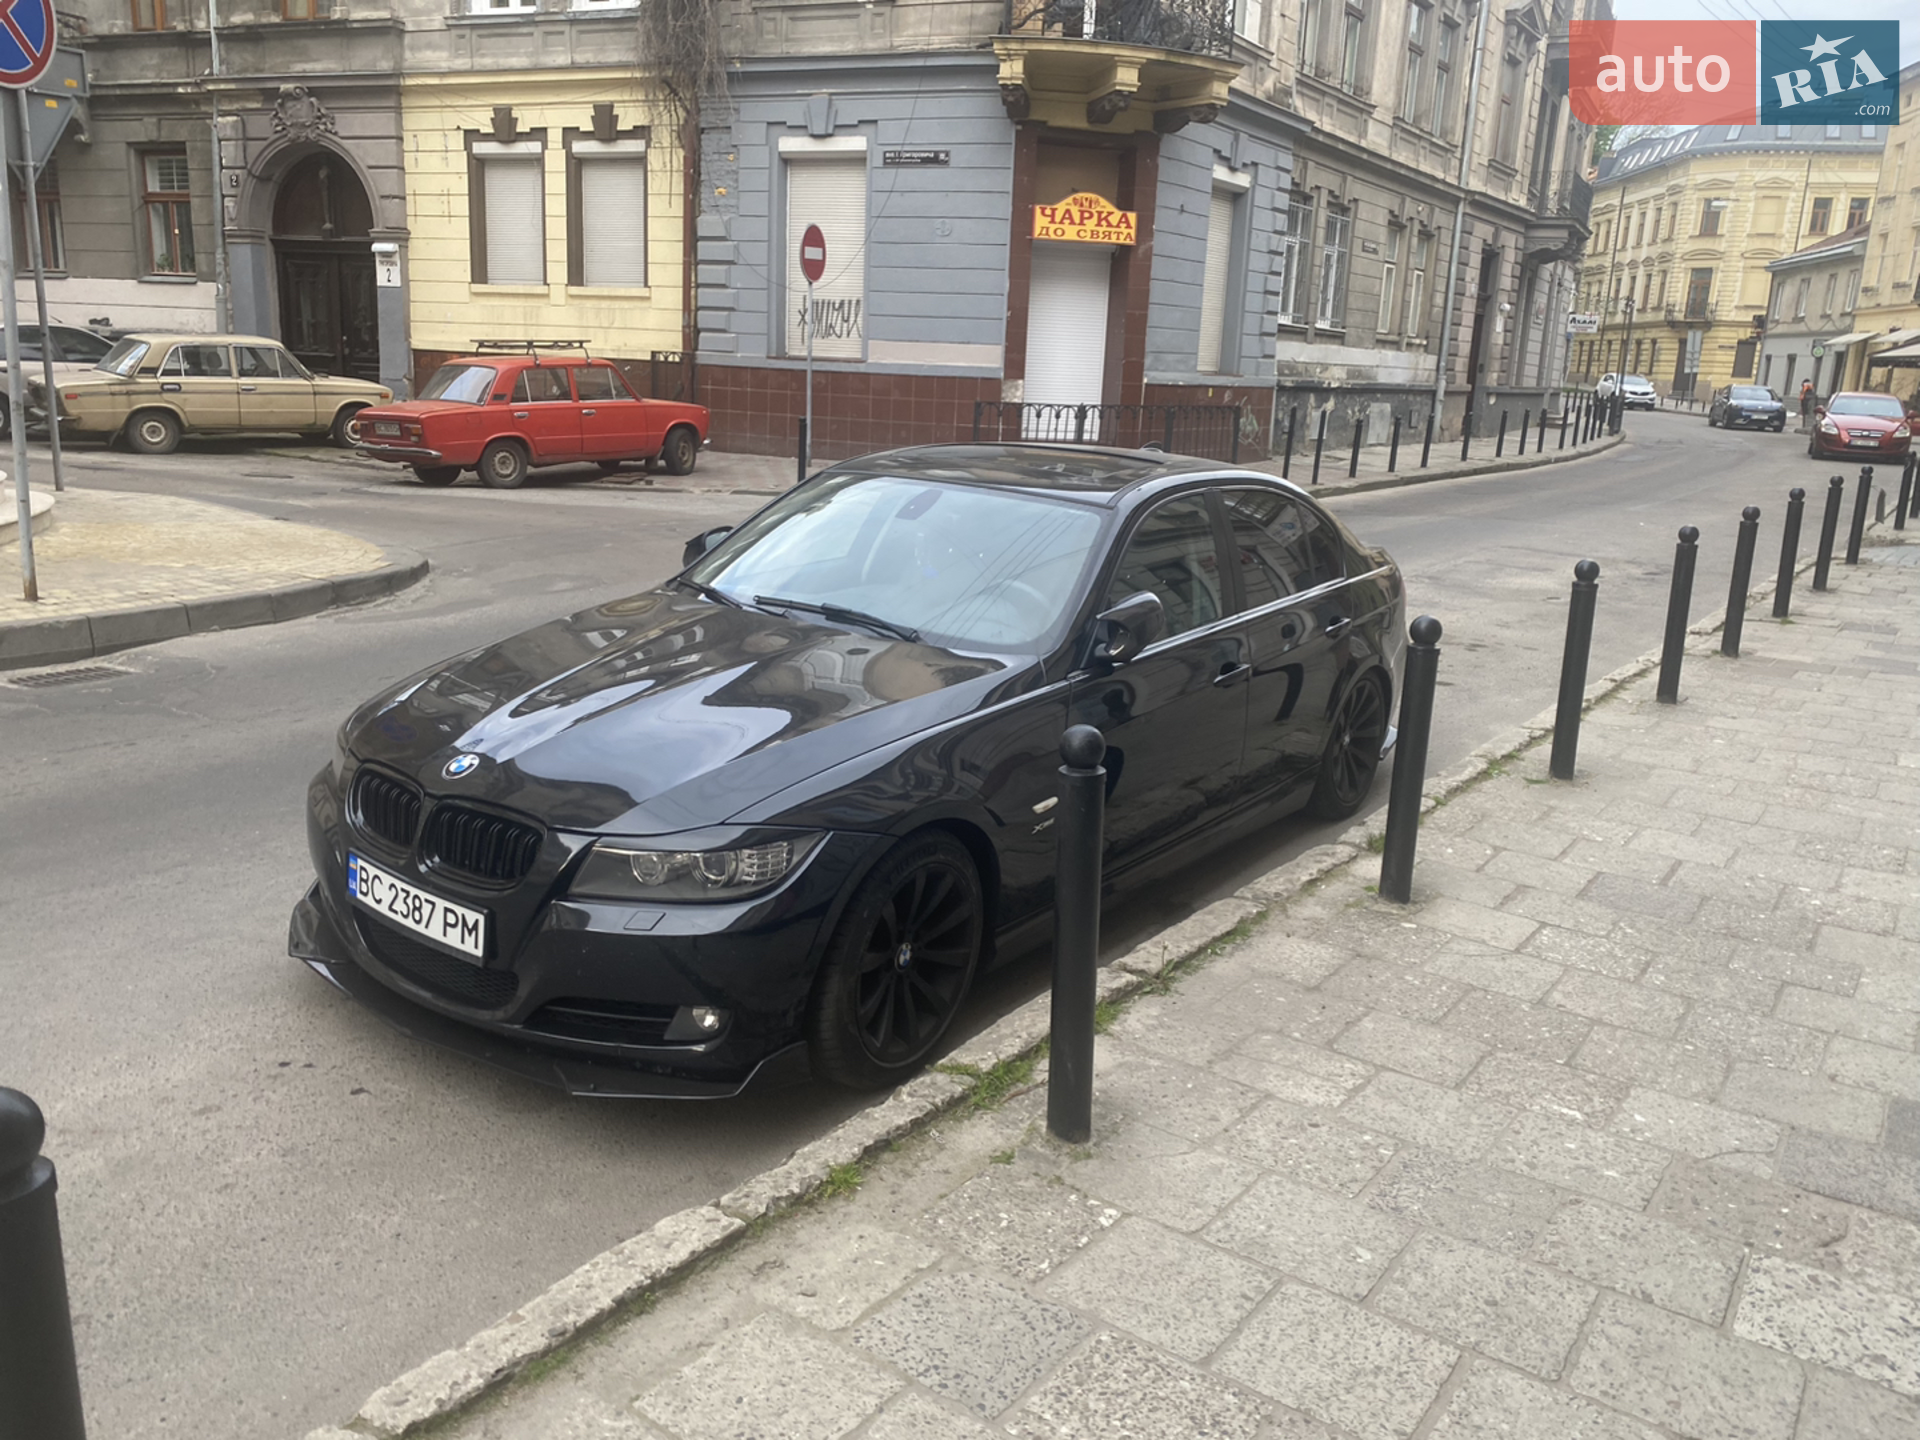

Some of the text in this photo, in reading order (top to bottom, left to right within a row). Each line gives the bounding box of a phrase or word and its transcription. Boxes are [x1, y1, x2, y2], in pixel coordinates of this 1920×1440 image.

[1038, 206, 1134, 230] ЧАРКА
[1037, 226, 1134, 242] ДО СВЯТА
[358, 864, 480, 951] BC 2387 PM
